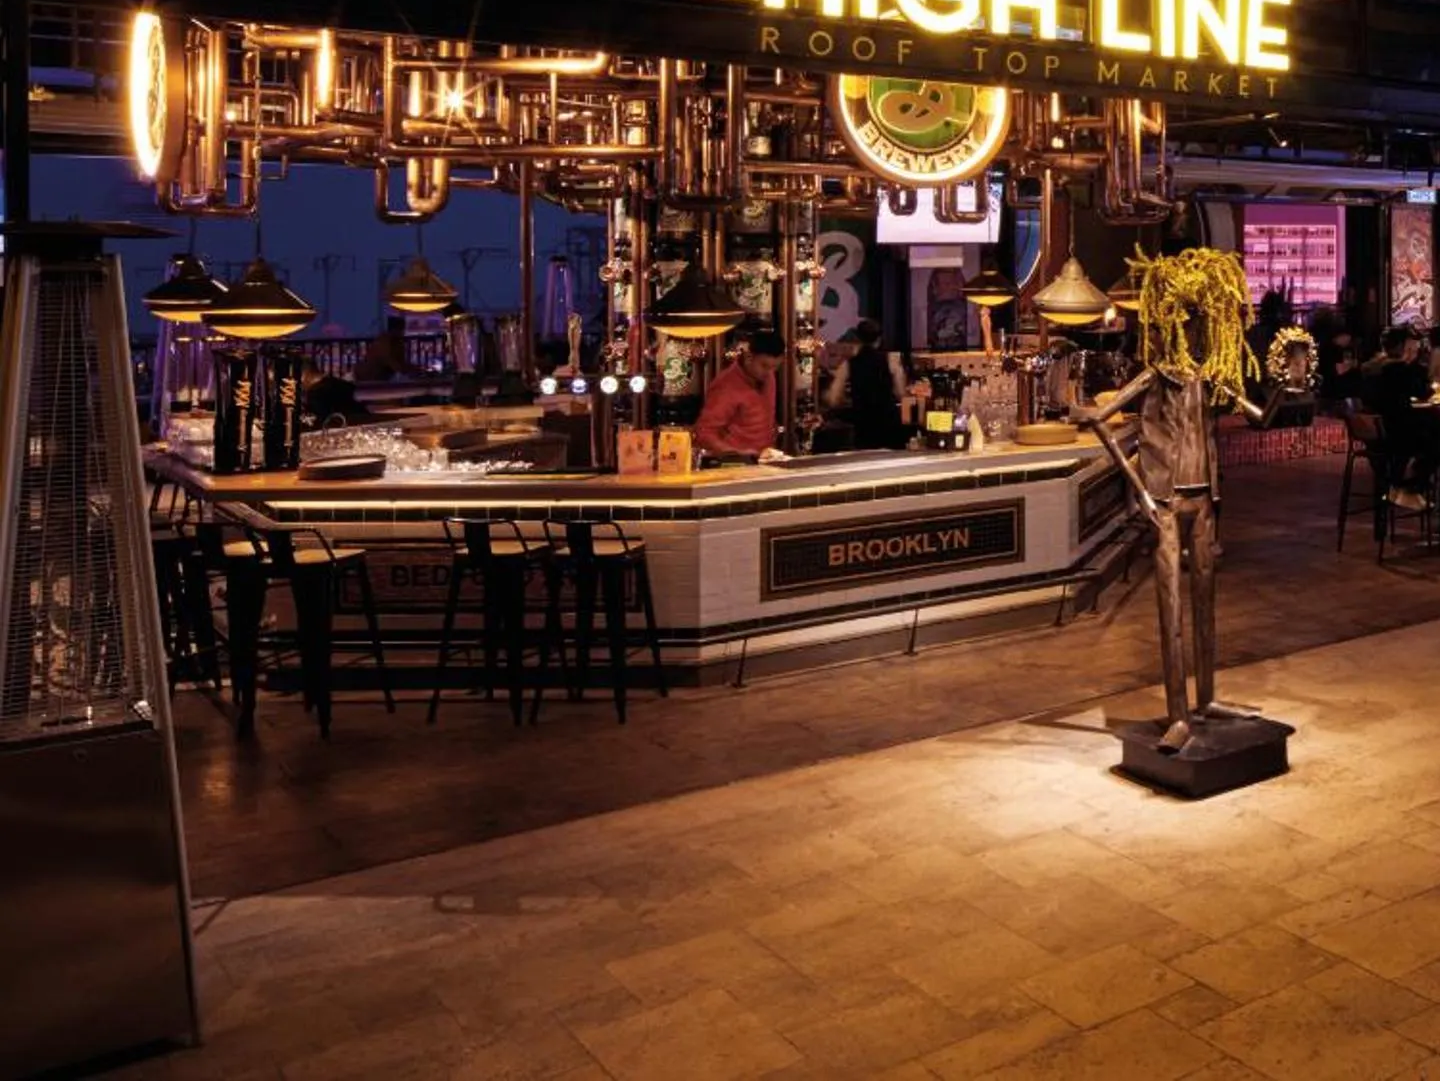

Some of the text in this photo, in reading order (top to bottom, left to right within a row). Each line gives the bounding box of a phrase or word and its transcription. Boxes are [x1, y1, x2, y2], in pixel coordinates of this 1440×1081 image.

[760, 26, 1279, 100] ROOF TOP MARKET
[857, 120, 981, 173] BREWERY
[828, 527, 970, 566] BROOKLYN
